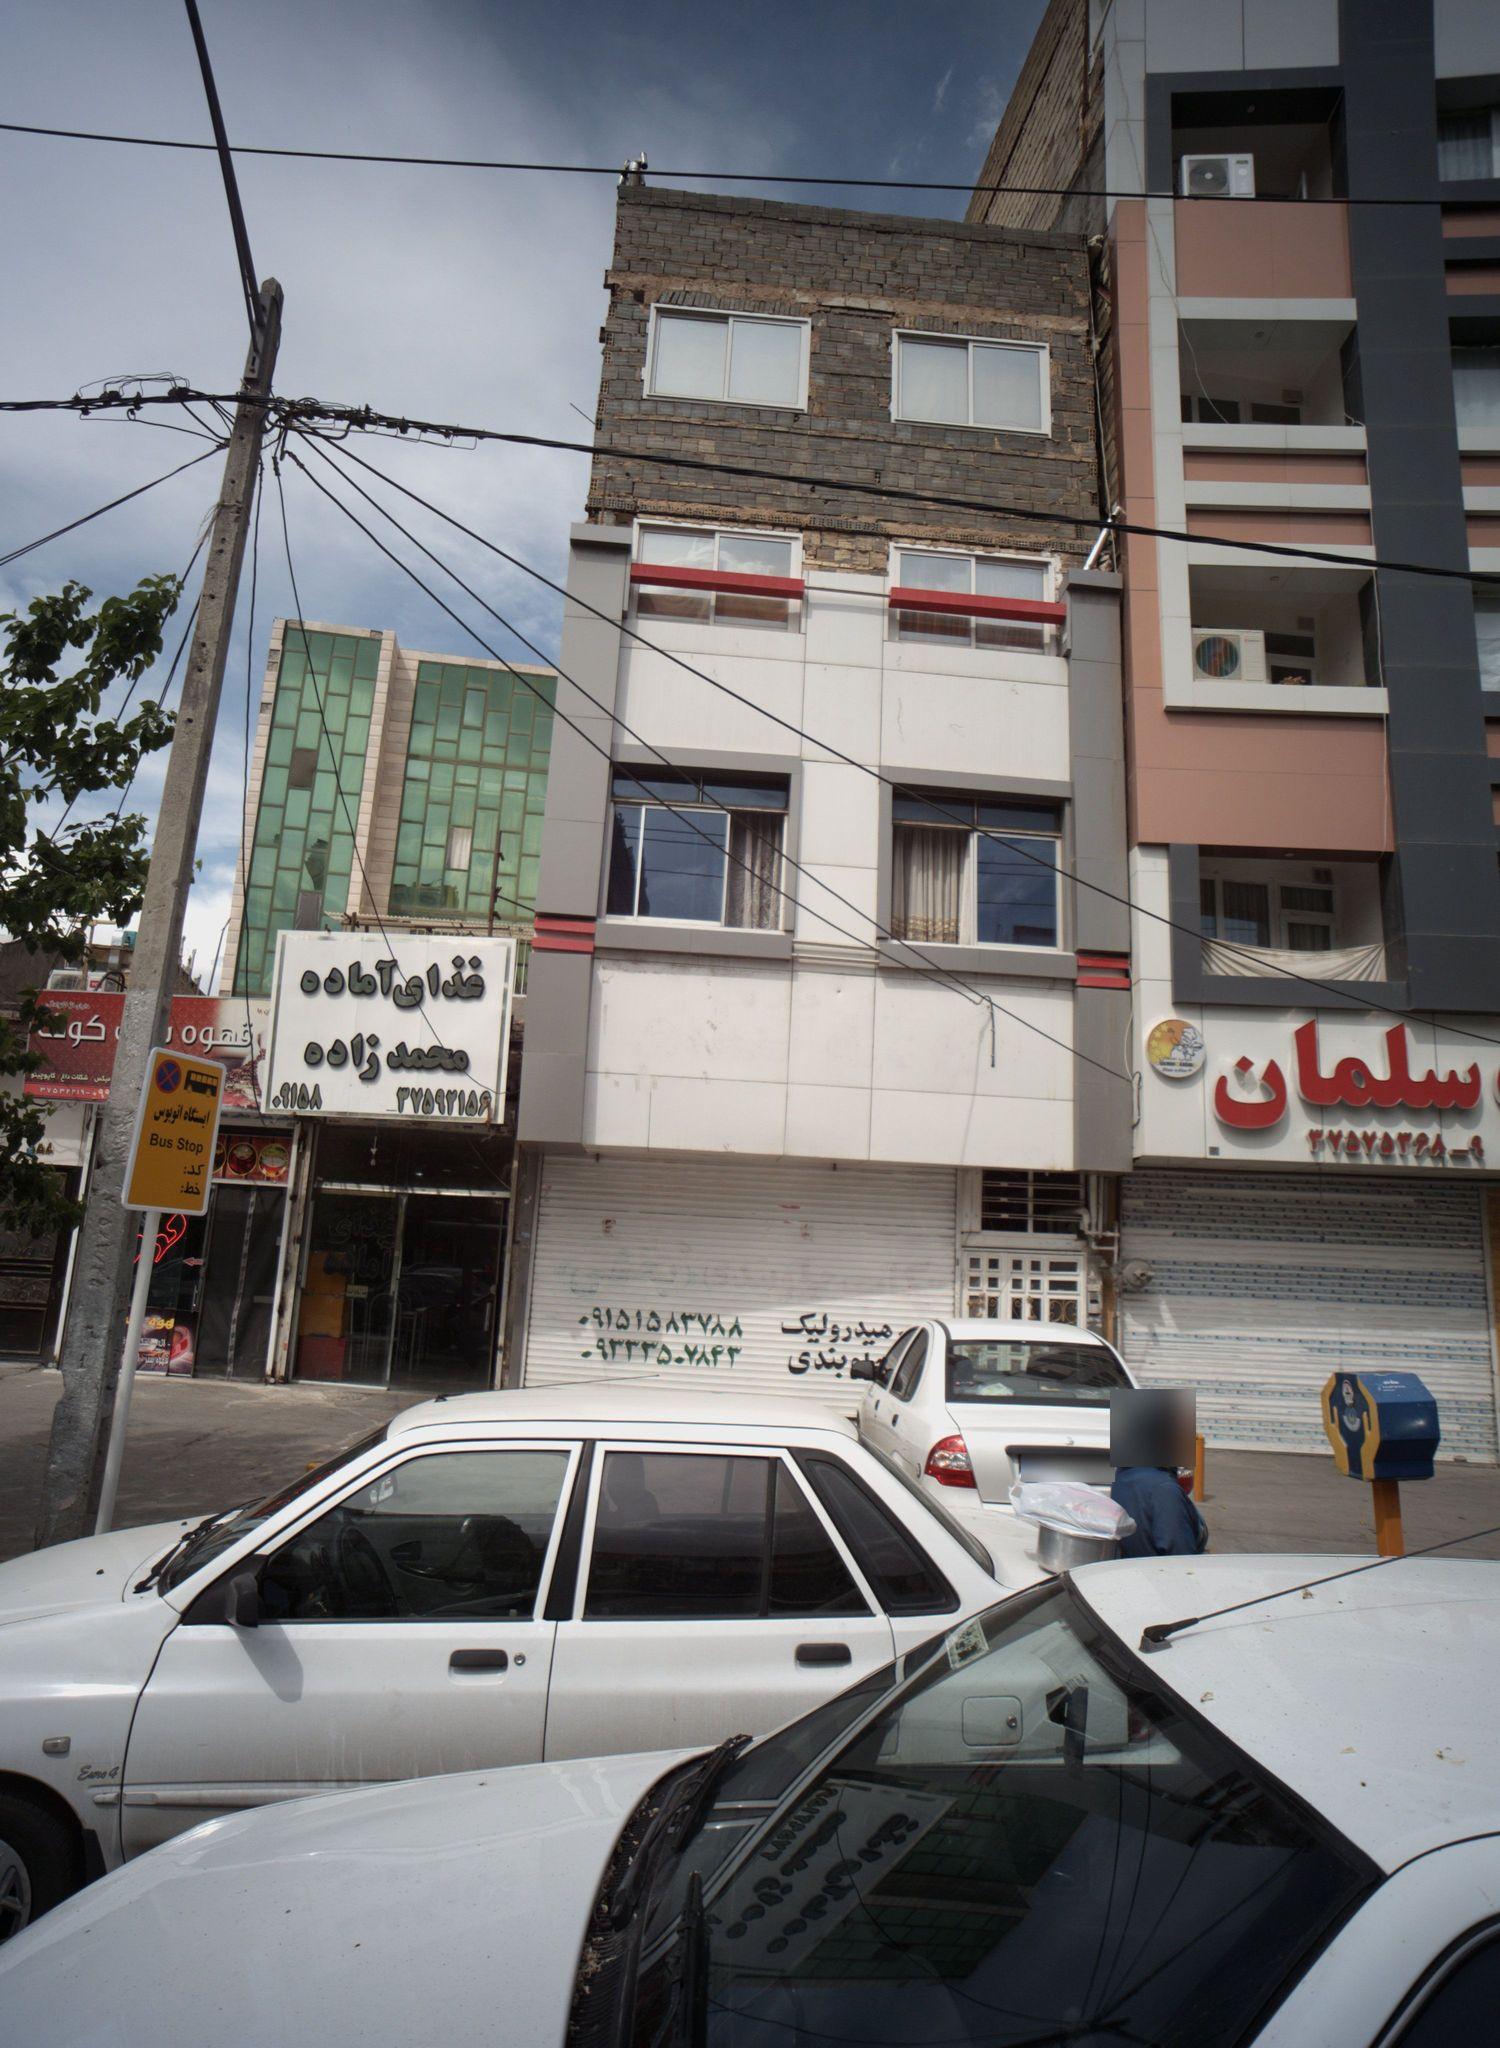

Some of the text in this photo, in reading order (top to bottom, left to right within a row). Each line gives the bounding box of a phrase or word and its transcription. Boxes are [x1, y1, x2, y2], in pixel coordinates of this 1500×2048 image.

[300, 955, 486, 1009] غذای آماده
[181, 1022, 253, 1055] قهوه
[304, 1032, 470, 1081] محمد زاده
[1214, 1018, 1483, 1130] سلمان
[272, 1082, 323, 1111] ۰۹۱۵۸
[153, 1103, 210, 1129] ایستگاه اتوبوس
[149, 1133, 204, 1154] Bus Stop
[183, 1163, 204, 1176] کد:
[180, 1181, 201, 1196] خط:
[578, 1306, 743, 1339] ۰۹۱۵۱۵۸۳۷۸۸
[781, 1312, 893, 1346] هیدرولیک
[581, 1338, 743, 1368] ۰۹۳۳۳۵۰۷۸۴۳
[77, 1764, 108, 1782] Euro
